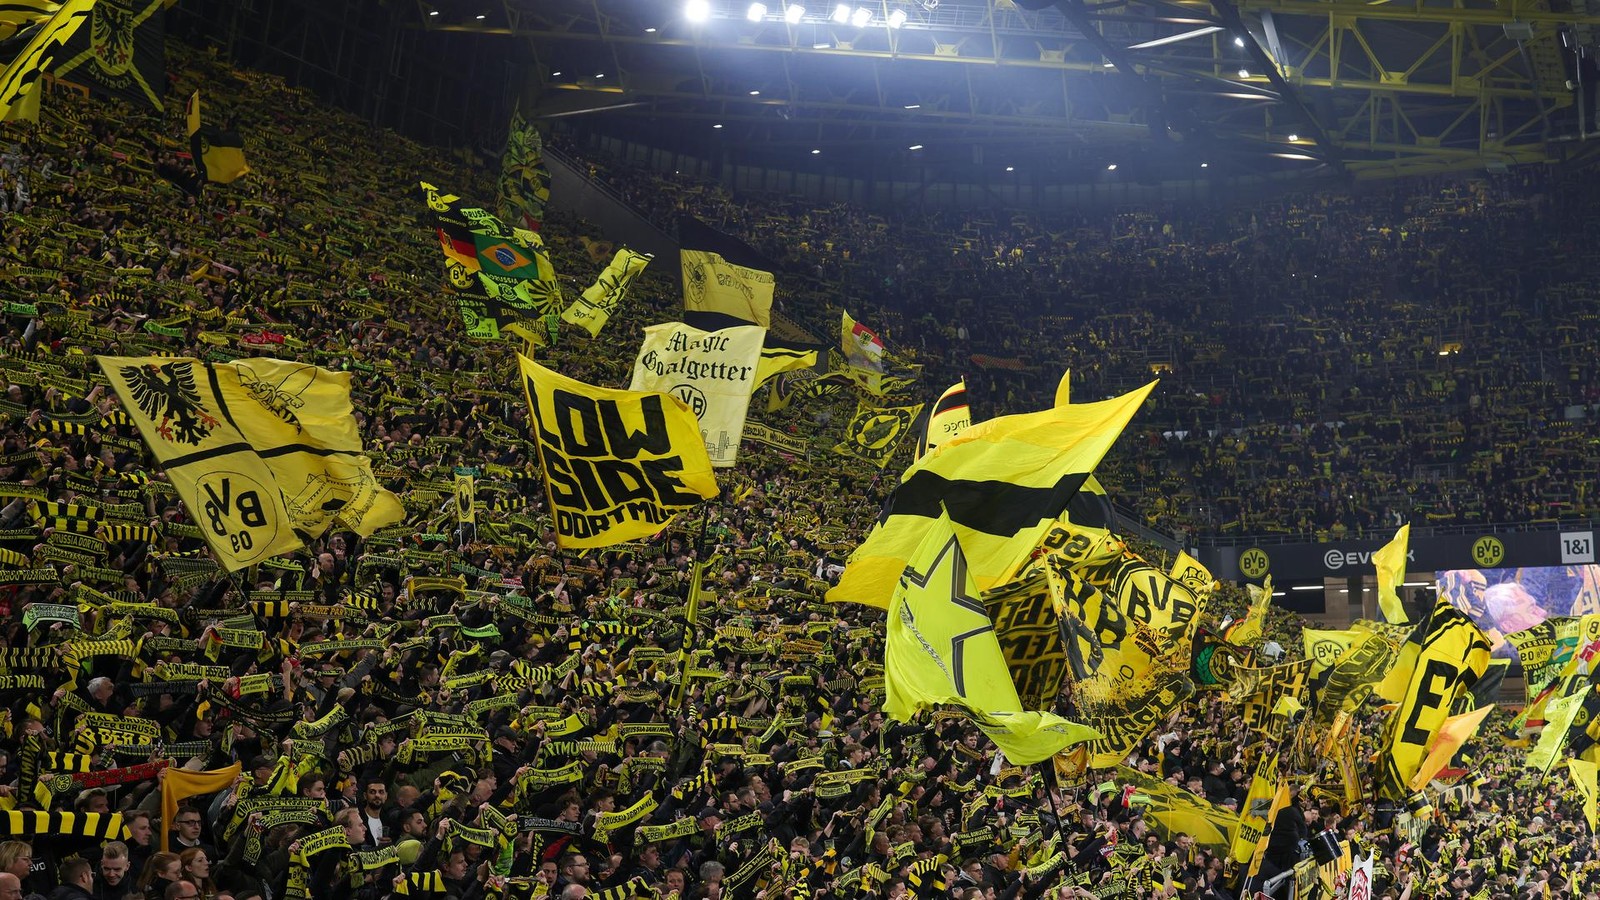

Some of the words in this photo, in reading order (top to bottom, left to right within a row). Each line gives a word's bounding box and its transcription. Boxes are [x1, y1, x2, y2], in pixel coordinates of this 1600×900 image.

[665, 331, 730, 352] Magic
[642, 350, 752, 381] Goalgetter
[527, 374, 672, 460] LOW
[541, 444, 706, 512] SIDE
[1477, 540, 1501, 558] BVB
[1564, 538, 1590, 555] 1&1
[1243, 551, 1266, 570] BVB
[1127, 576, 1196, 625] BVB
[341, 641, 359, 649] WALK
[1317, 641, 1341, 660] BVB
[546, 741, 579, 756] RTMU
[677, 826, 694, 836] STADT
